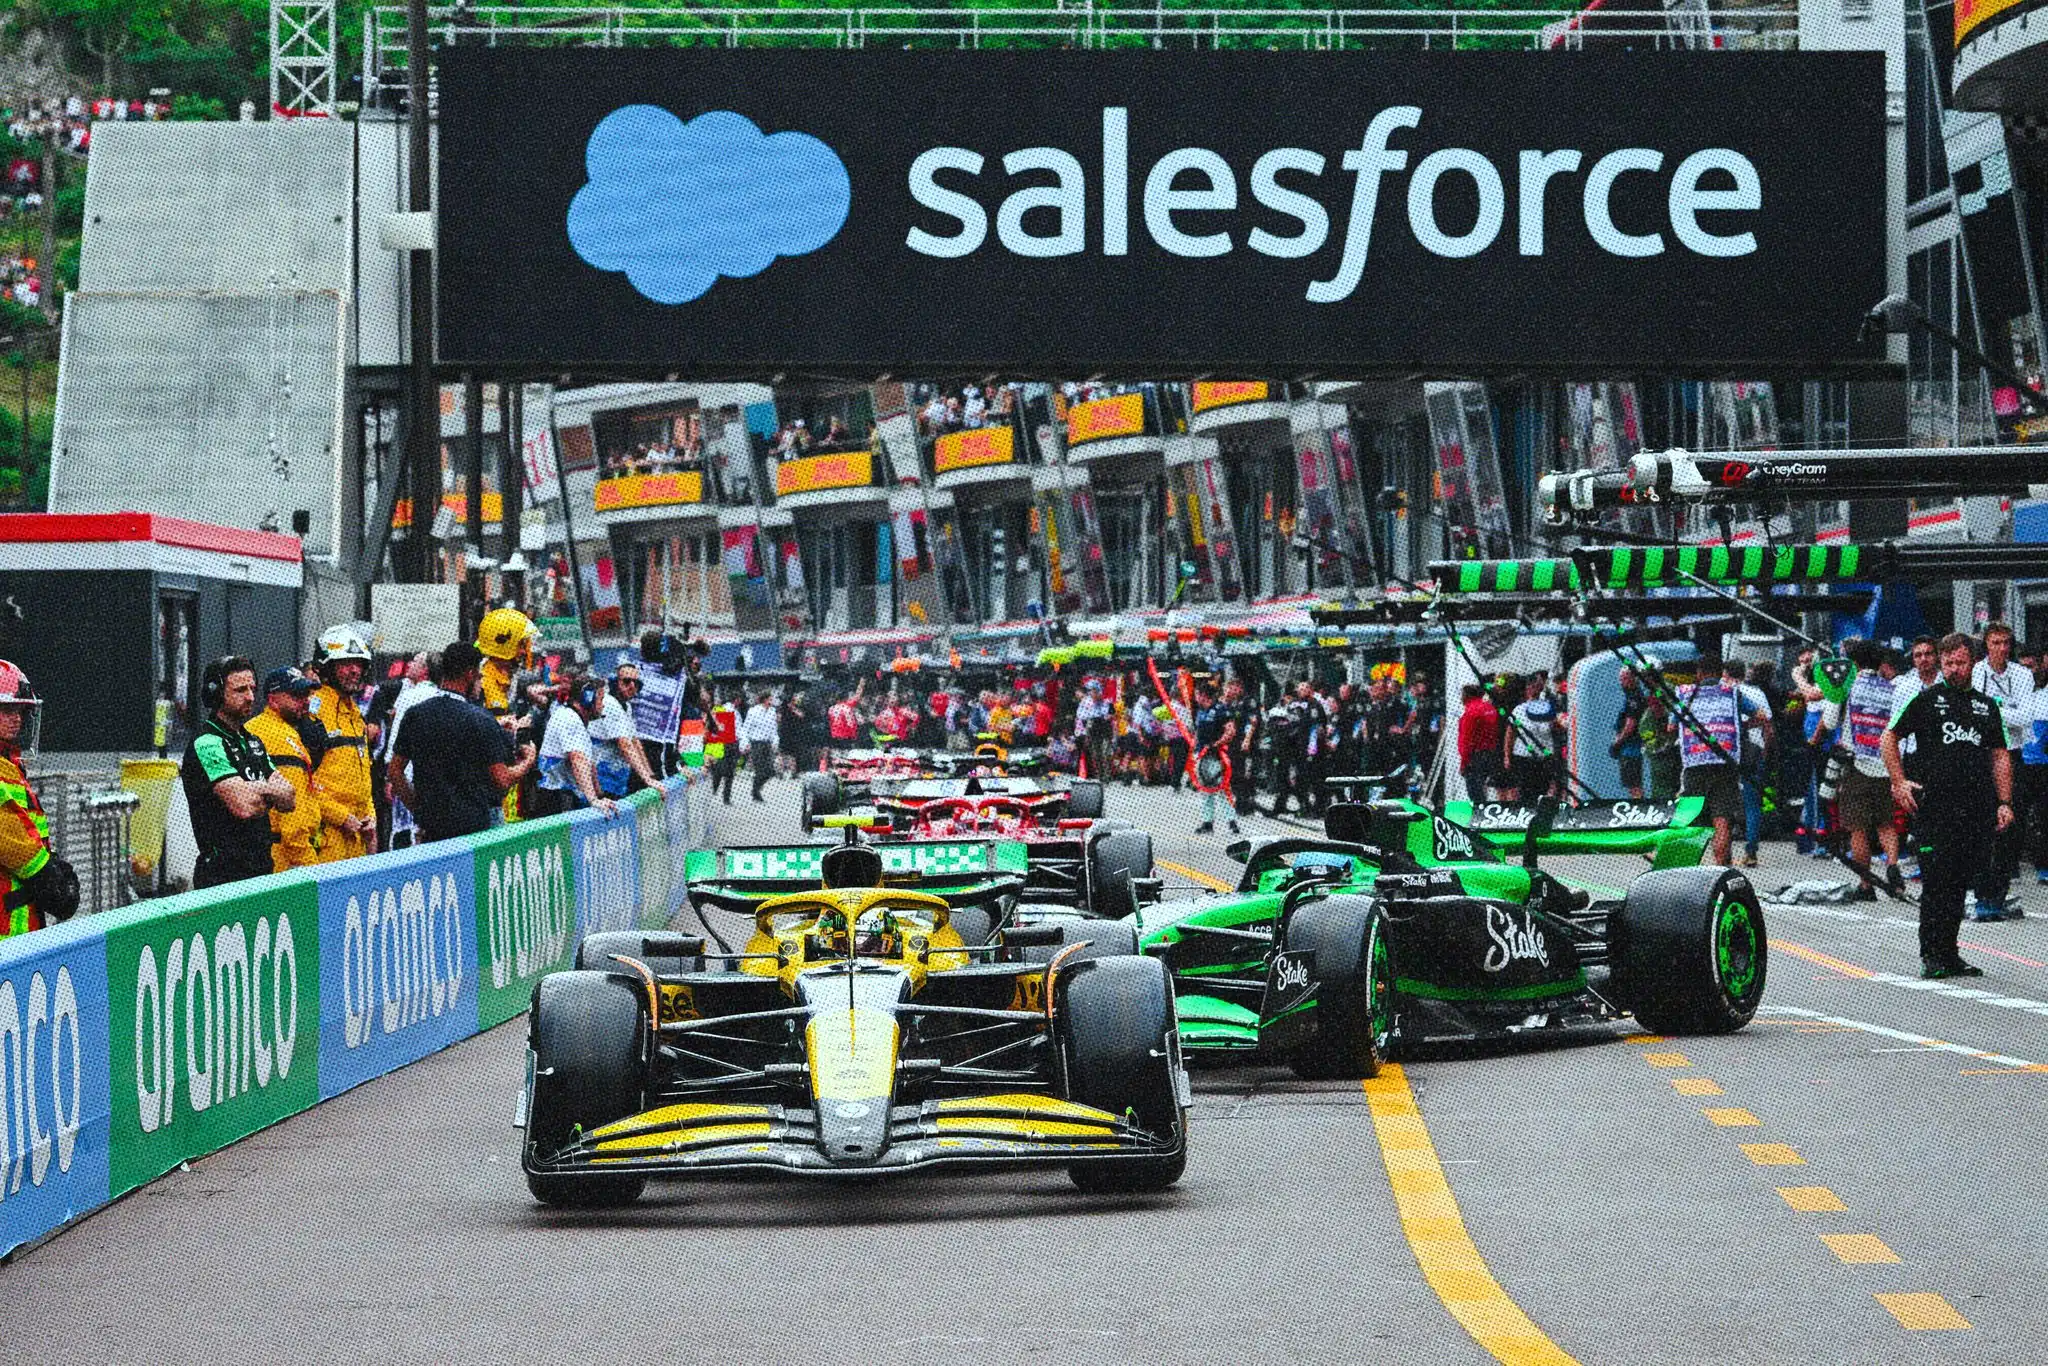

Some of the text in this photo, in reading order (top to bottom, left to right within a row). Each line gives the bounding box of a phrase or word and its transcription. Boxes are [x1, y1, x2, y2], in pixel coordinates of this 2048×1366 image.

[906, 105, 1763, 304] salesforce
[1942, 721, 1982, 746] Stake
[1435, 816, 1474, 860] Stake
[1610, 802, 1666, 828] Stake
[488, 843, 567, 989] aramco
[1483, 904, 1550, 973] Stake
[344, 872, 463, 1049] aramco
[1276, 957, 1309, 991] Stake
[135, 912, 298, 1134] aramco
